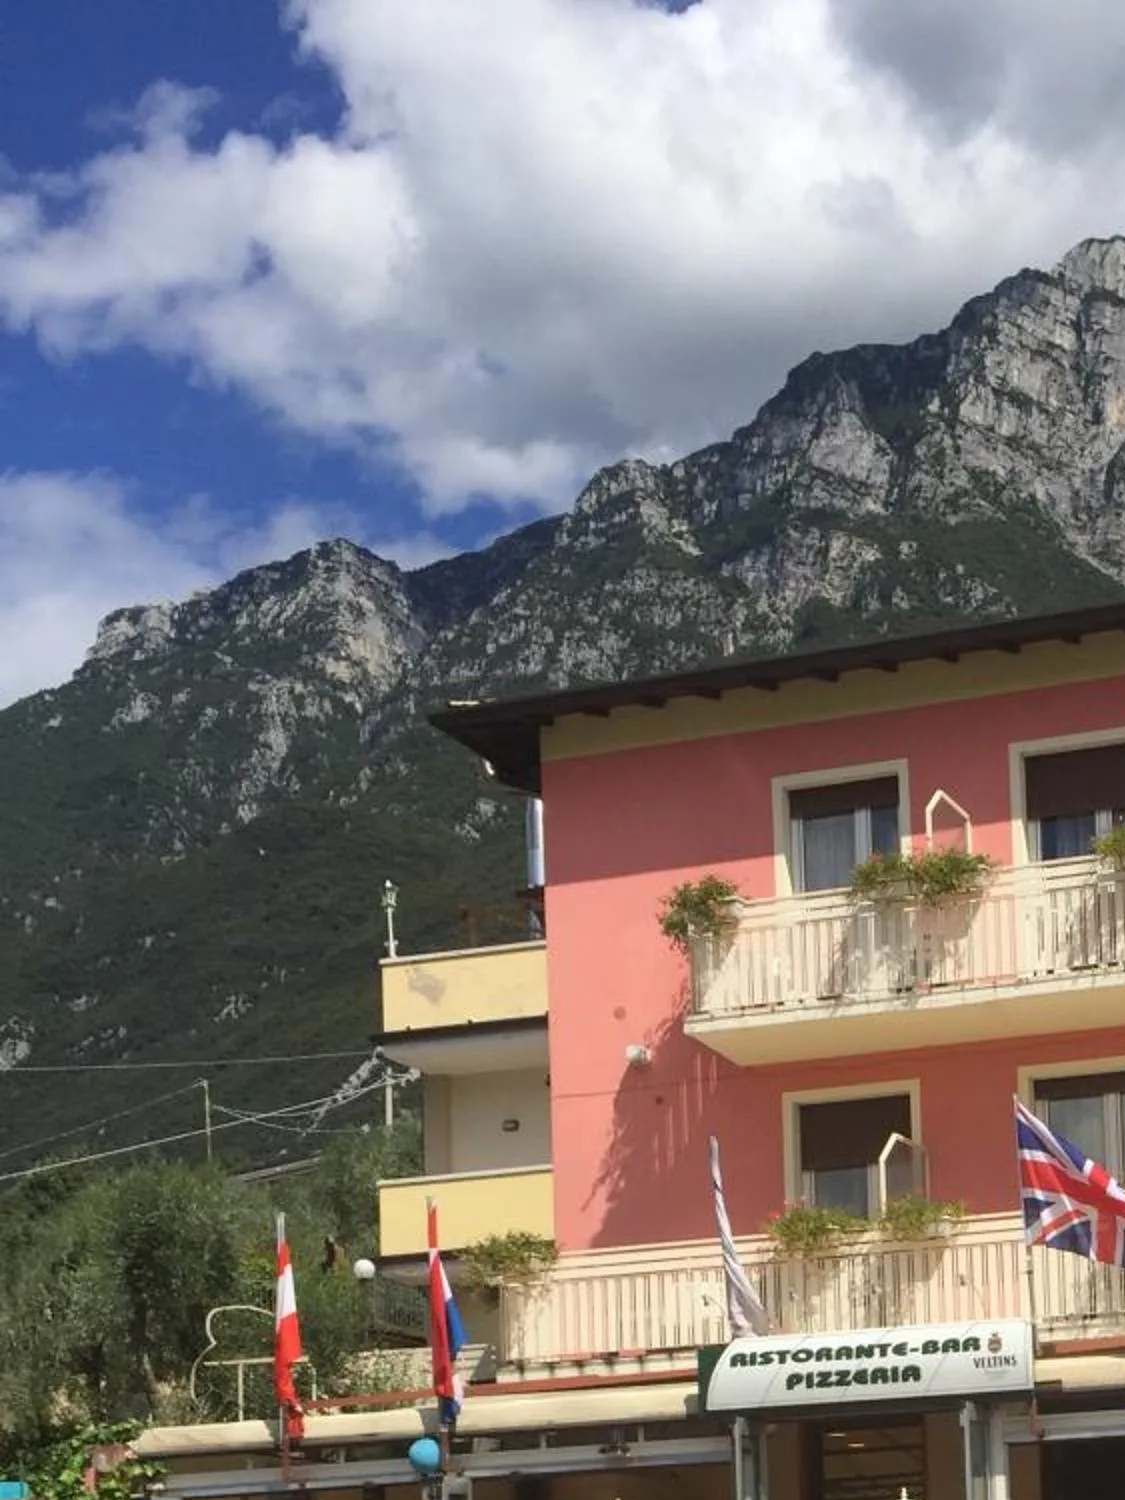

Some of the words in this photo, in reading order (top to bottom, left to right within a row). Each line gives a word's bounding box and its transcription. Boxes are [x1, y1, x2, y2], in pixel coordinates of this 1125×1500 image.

[729, 1336, 982, 1368] RISTORANTE-BAR
[973, 1354, 1017, 1369] VELTINS
[786, 1364, 922, 1391] PIZZERIA
